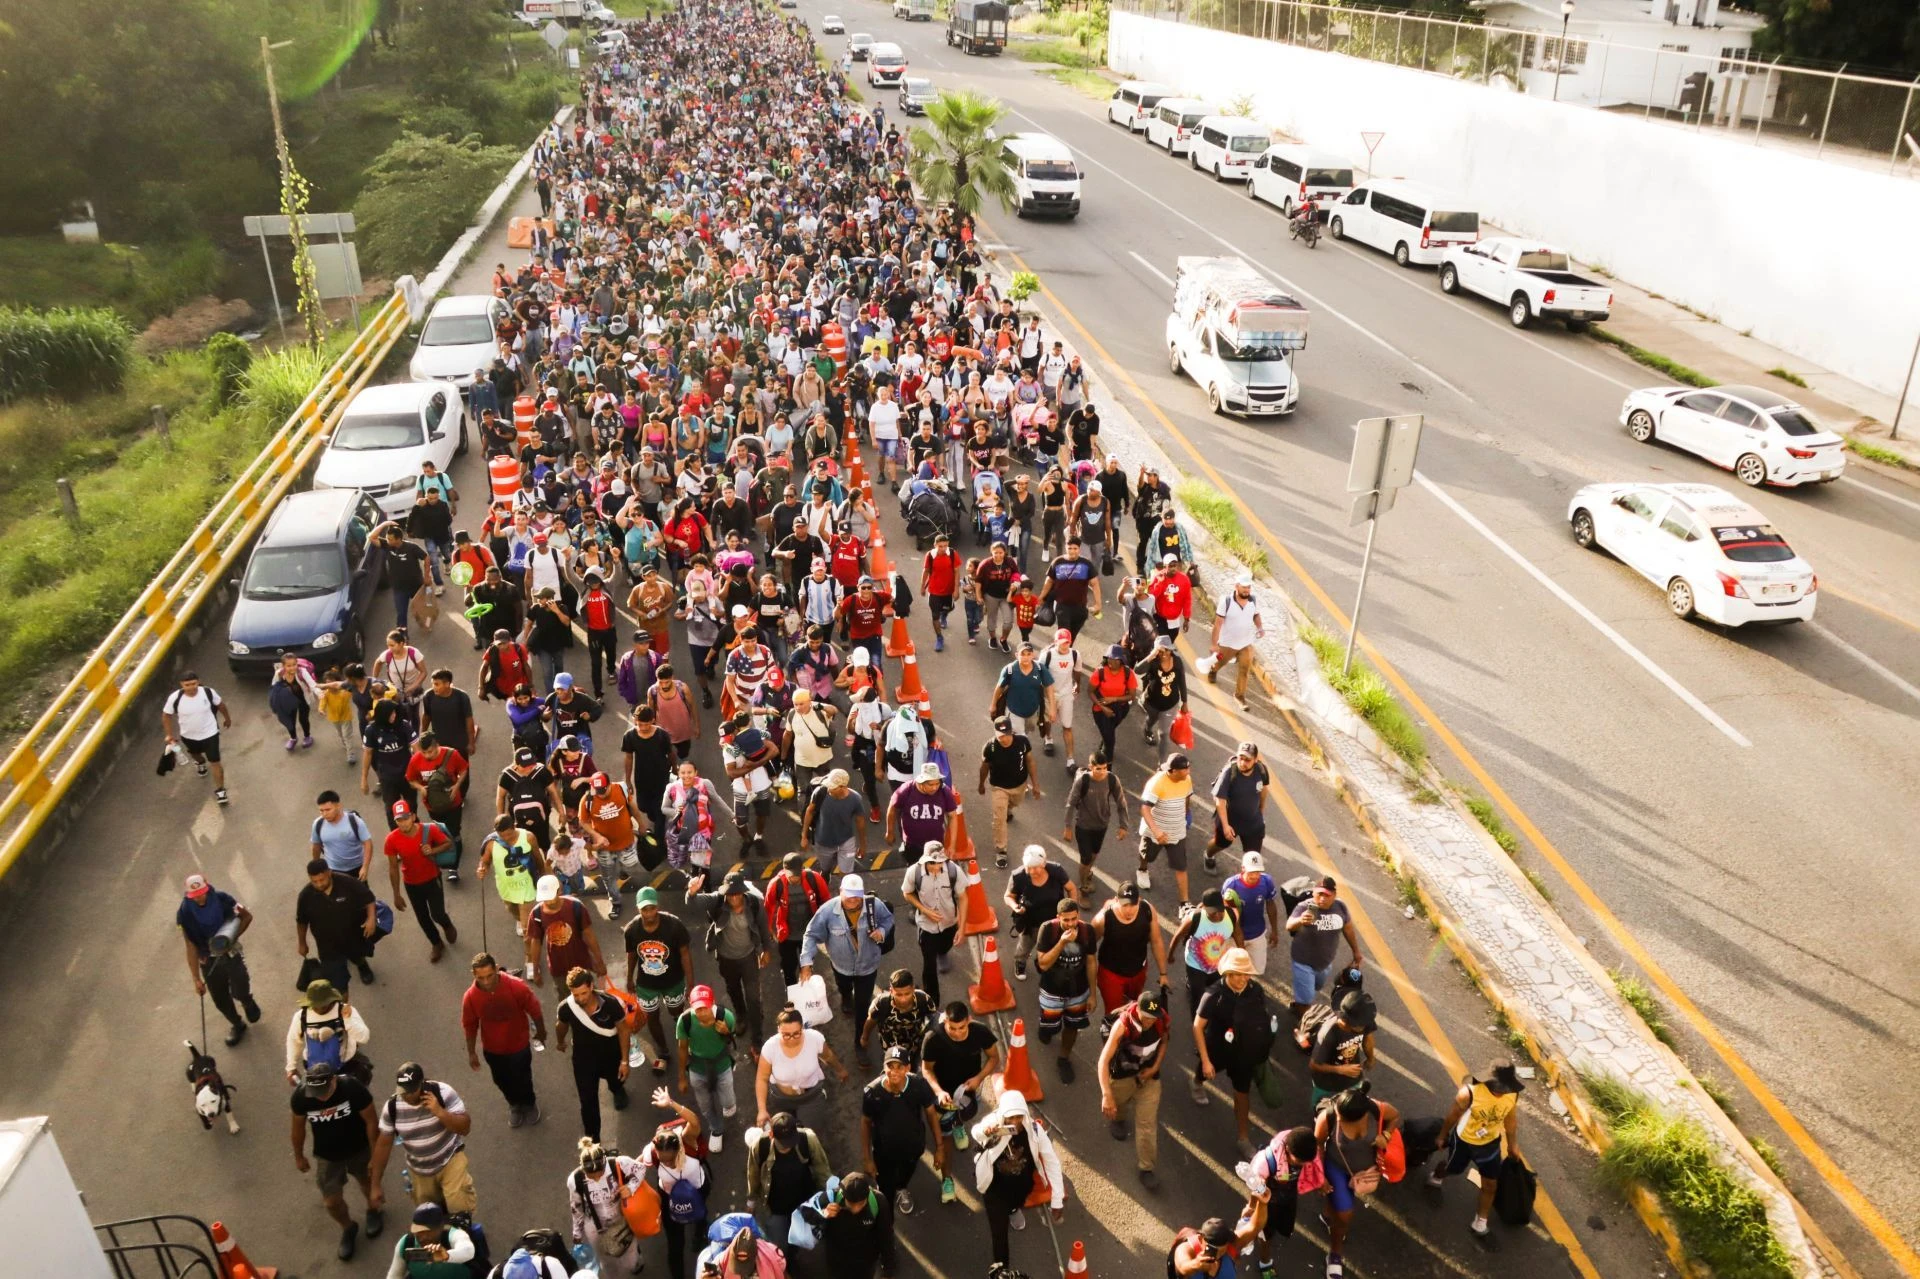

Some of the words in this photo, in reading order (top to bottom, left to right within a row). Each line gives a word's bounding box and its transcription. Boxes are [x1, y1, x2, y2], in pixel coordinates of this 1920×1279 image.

[1166, 535, 1179, 547] M
[1059, 661, 1069, 669] W
[910, 804, 943, 820] GAP
[307, 1105, 352, 1122] OWLS
[675, 1202, 693, 1212] OIM
